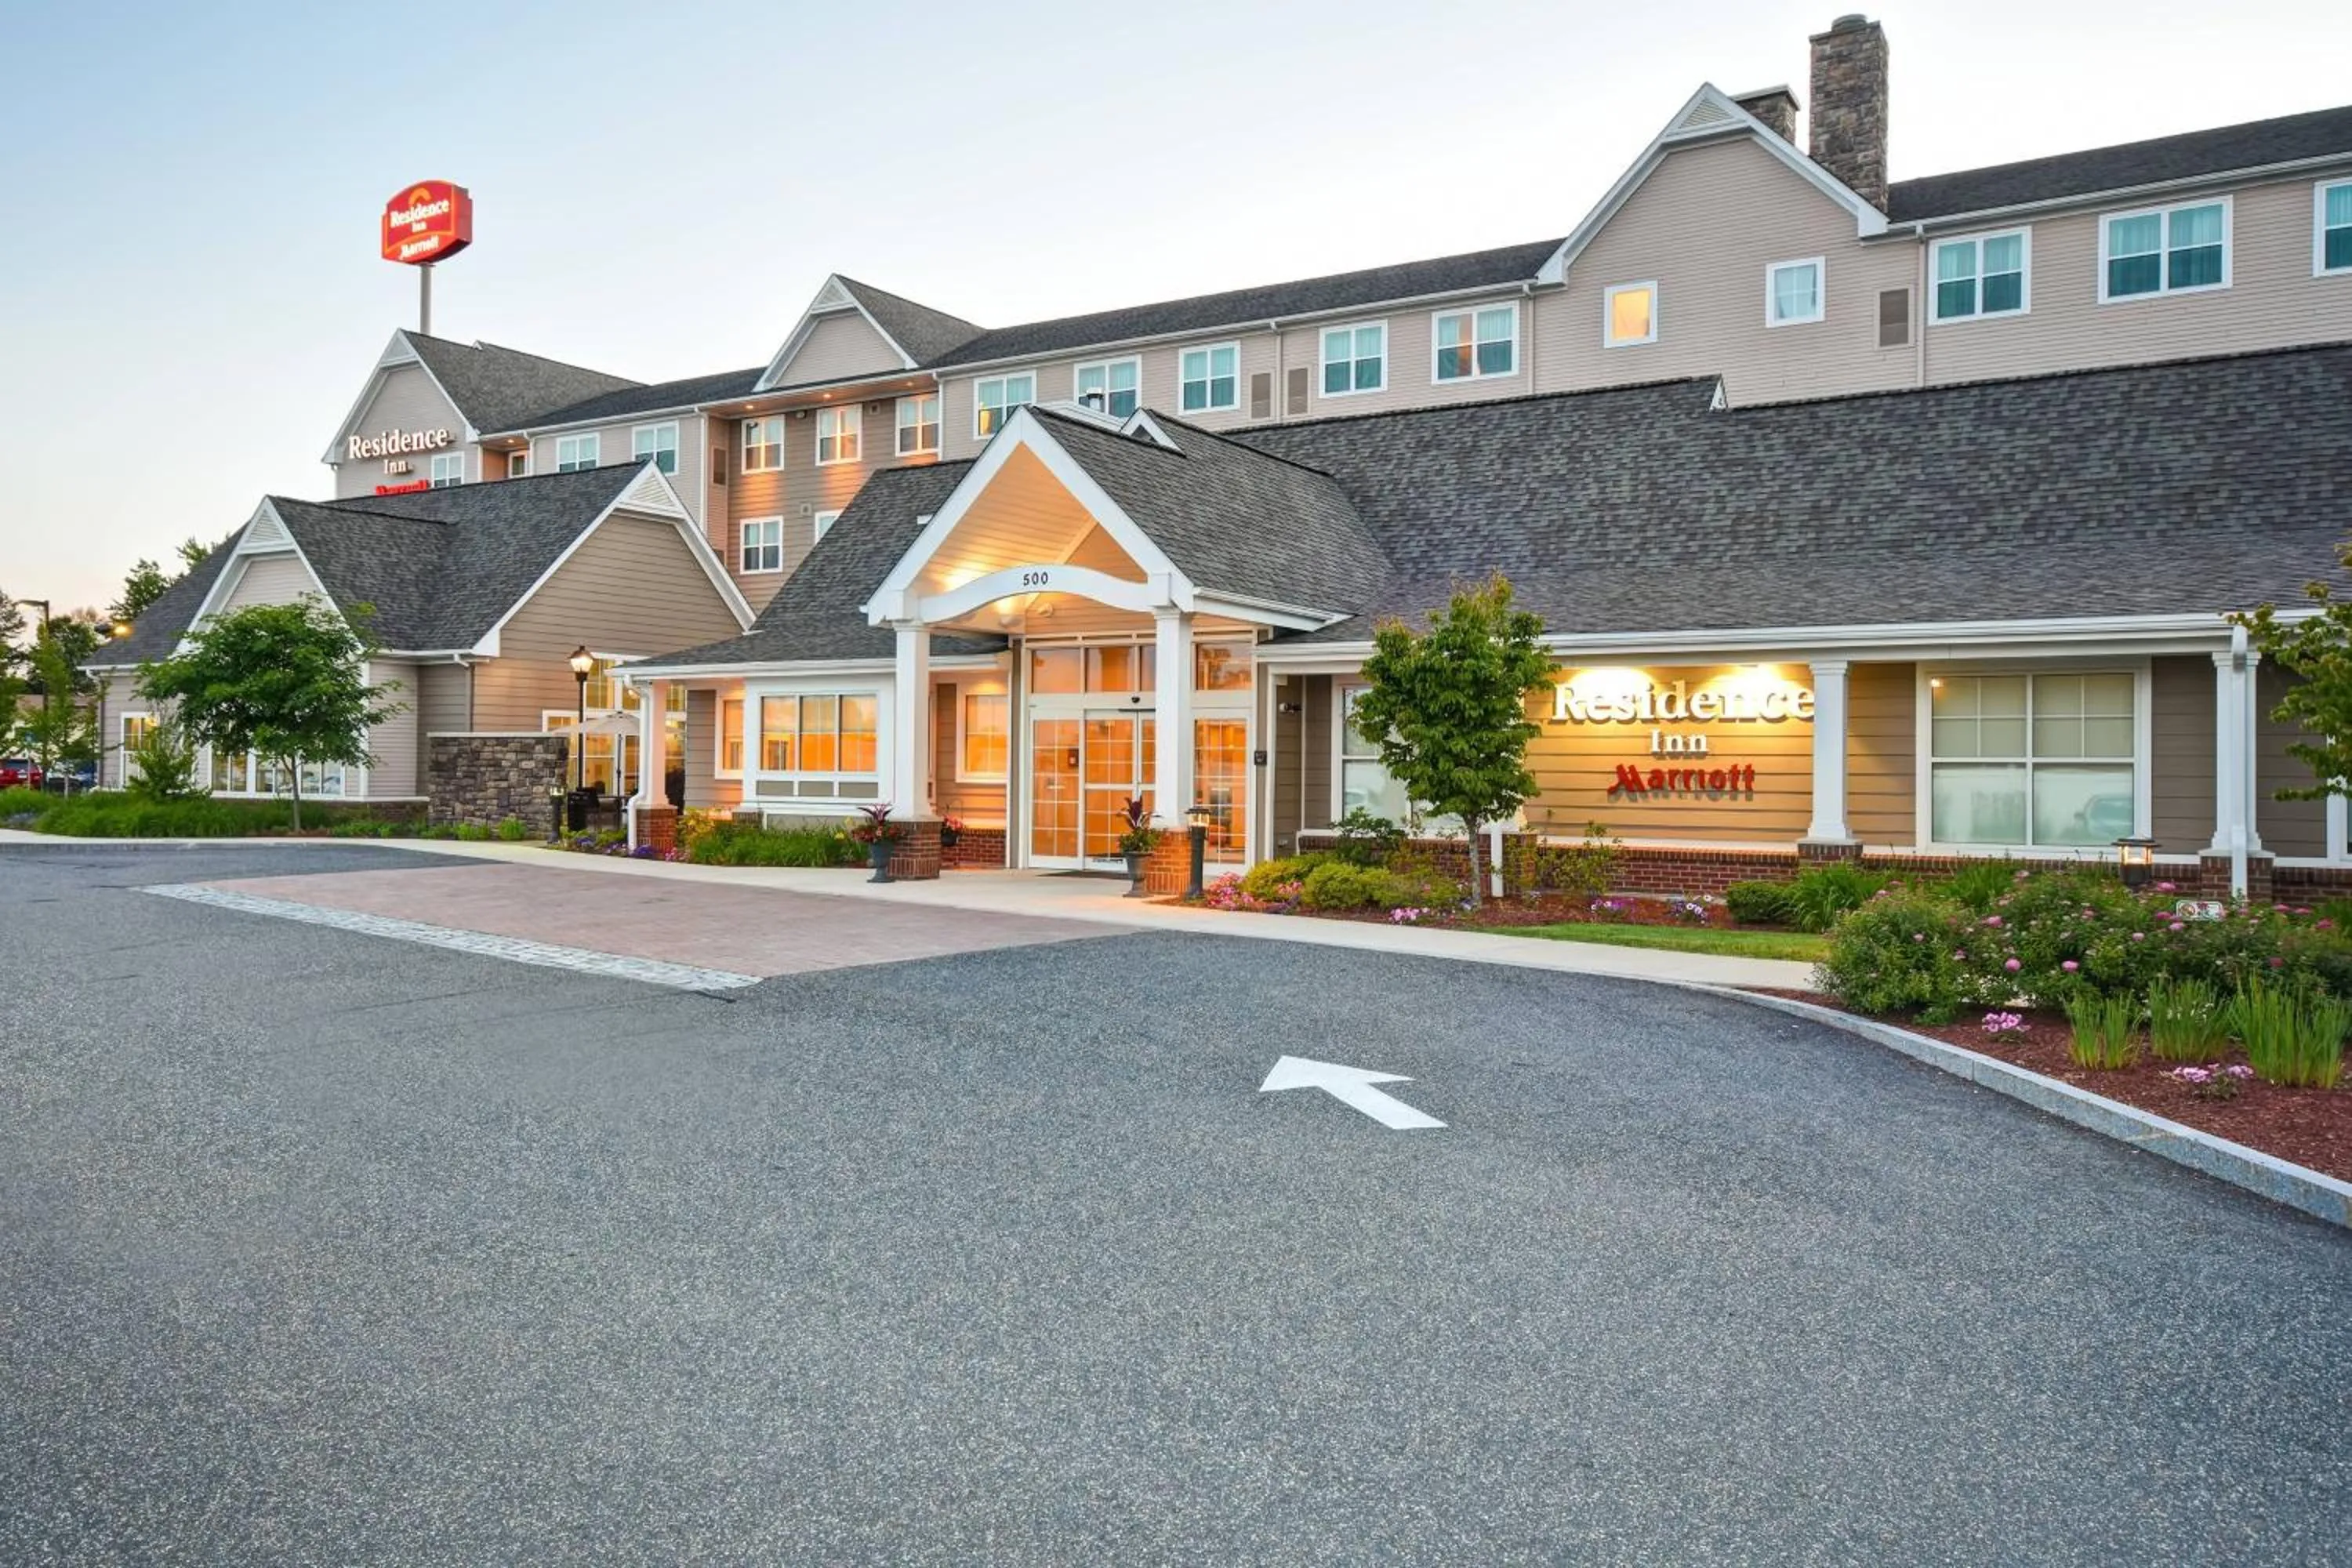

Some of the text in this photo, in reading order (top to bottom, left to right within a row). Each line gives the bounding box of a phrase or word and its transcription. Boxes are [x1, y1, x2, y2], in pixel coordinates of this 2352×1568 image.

[390, 199, 449, 228] Residence
[349, 428, 448, 459] Residence
[383, 459, 408, 474] Inn
[1023, 572, 1048, 586] 500
[1552, 681, 1814, 720] Residence
[1650, 728, 1709, 753] Inn
[1608, 764, 1755, 792] Marriott
